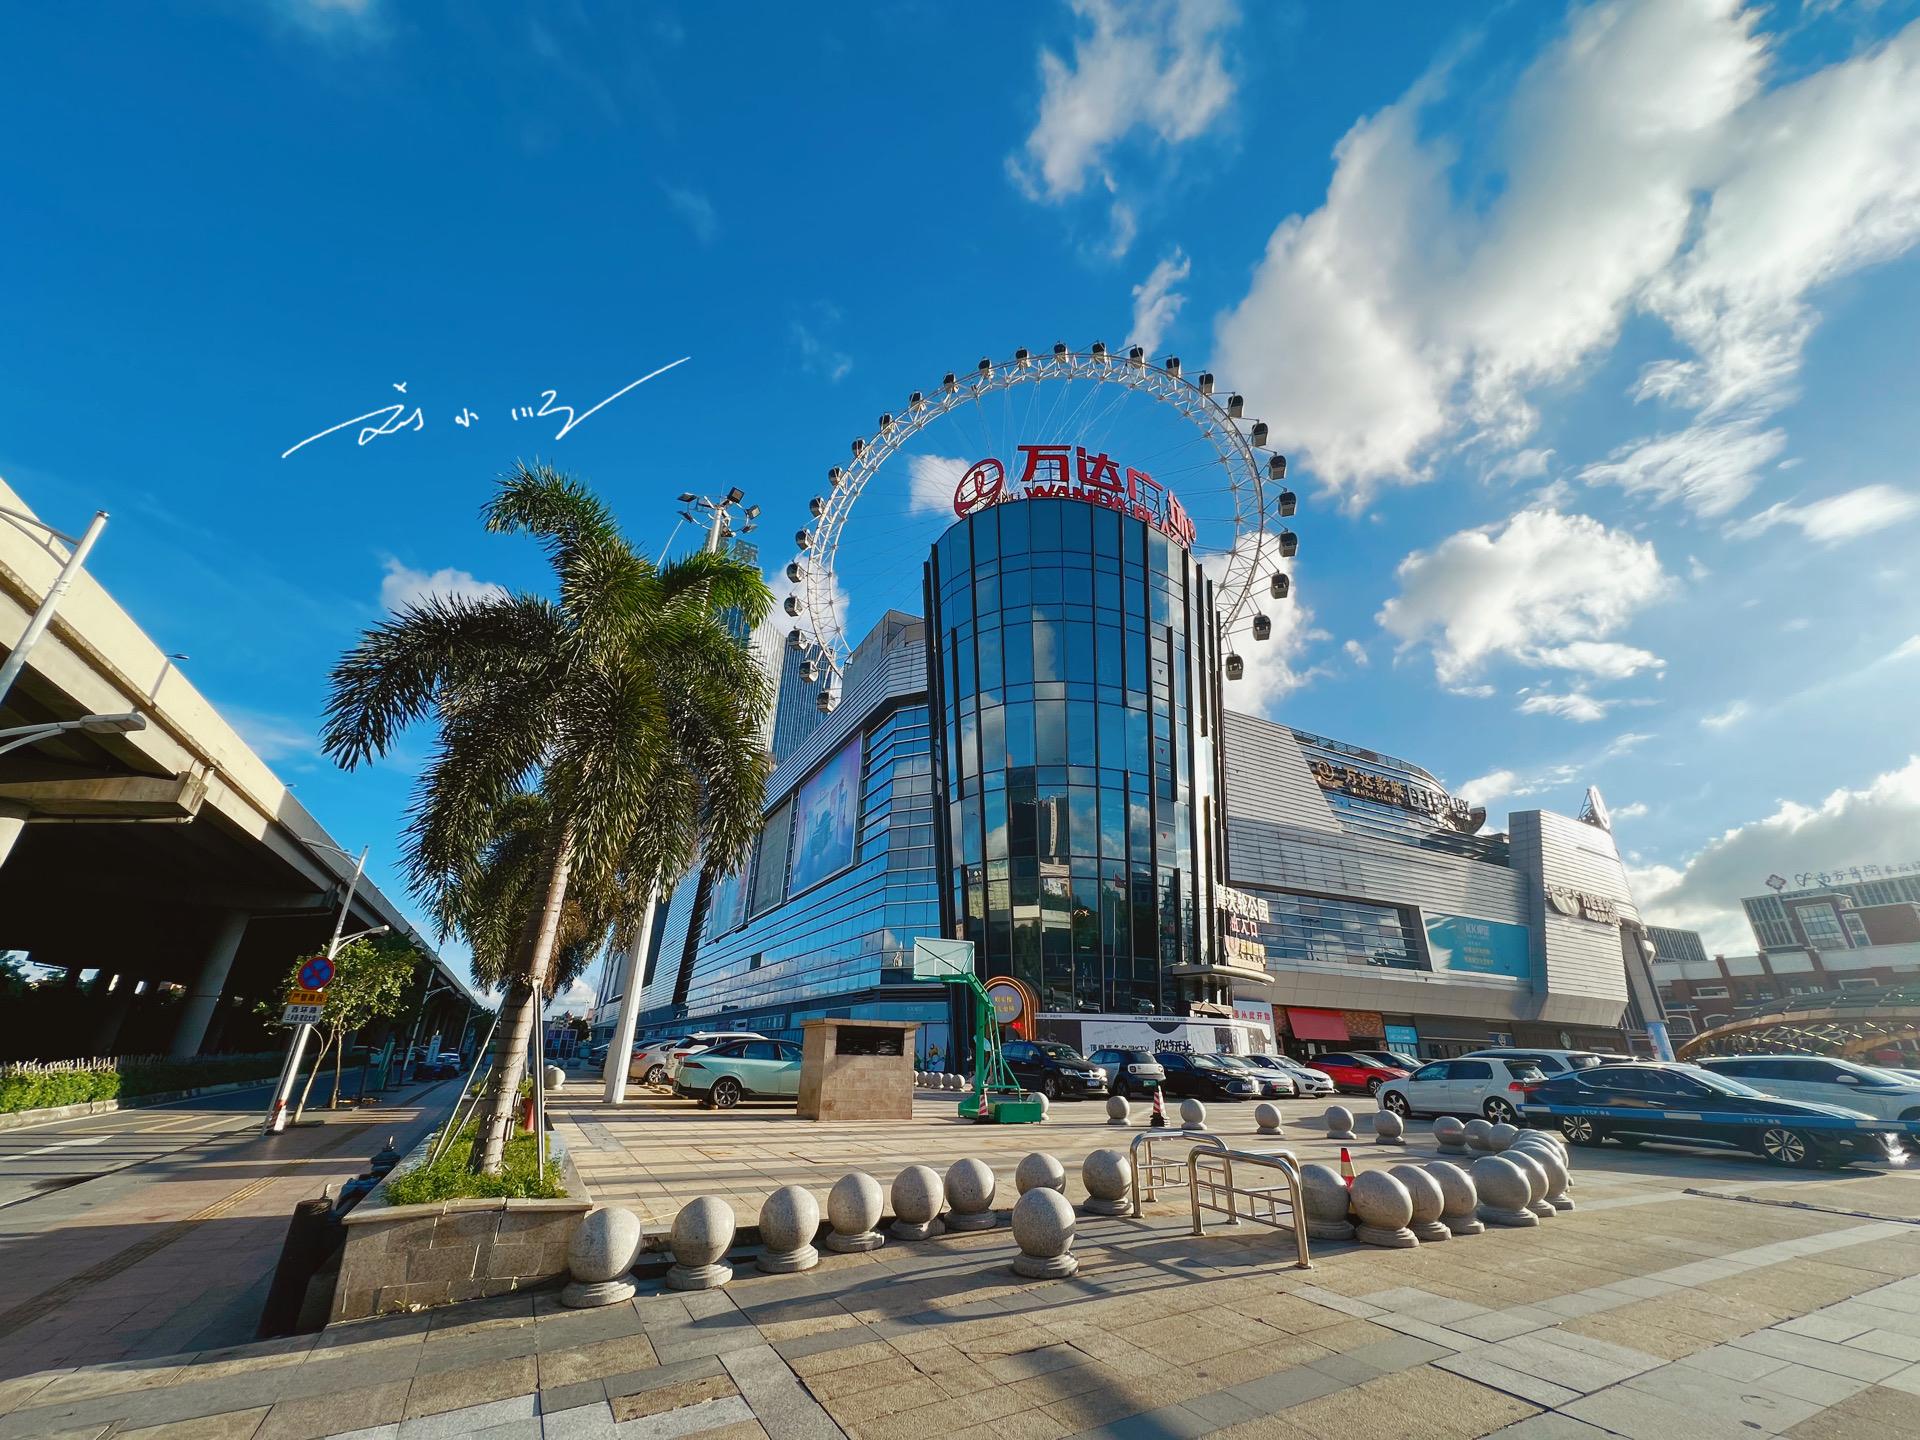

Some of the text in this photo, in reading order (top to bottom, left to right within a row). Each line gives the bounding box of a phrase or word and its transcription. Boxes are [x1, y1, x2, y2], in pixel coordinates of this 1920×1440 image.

[1017, 445, 1197, 545] 万达广场
[1024, 485, 1128, 514] WANDA
[1345, 768, 1405, 798] 万达影城
[1230, 911, 1258, 938] 出入口
